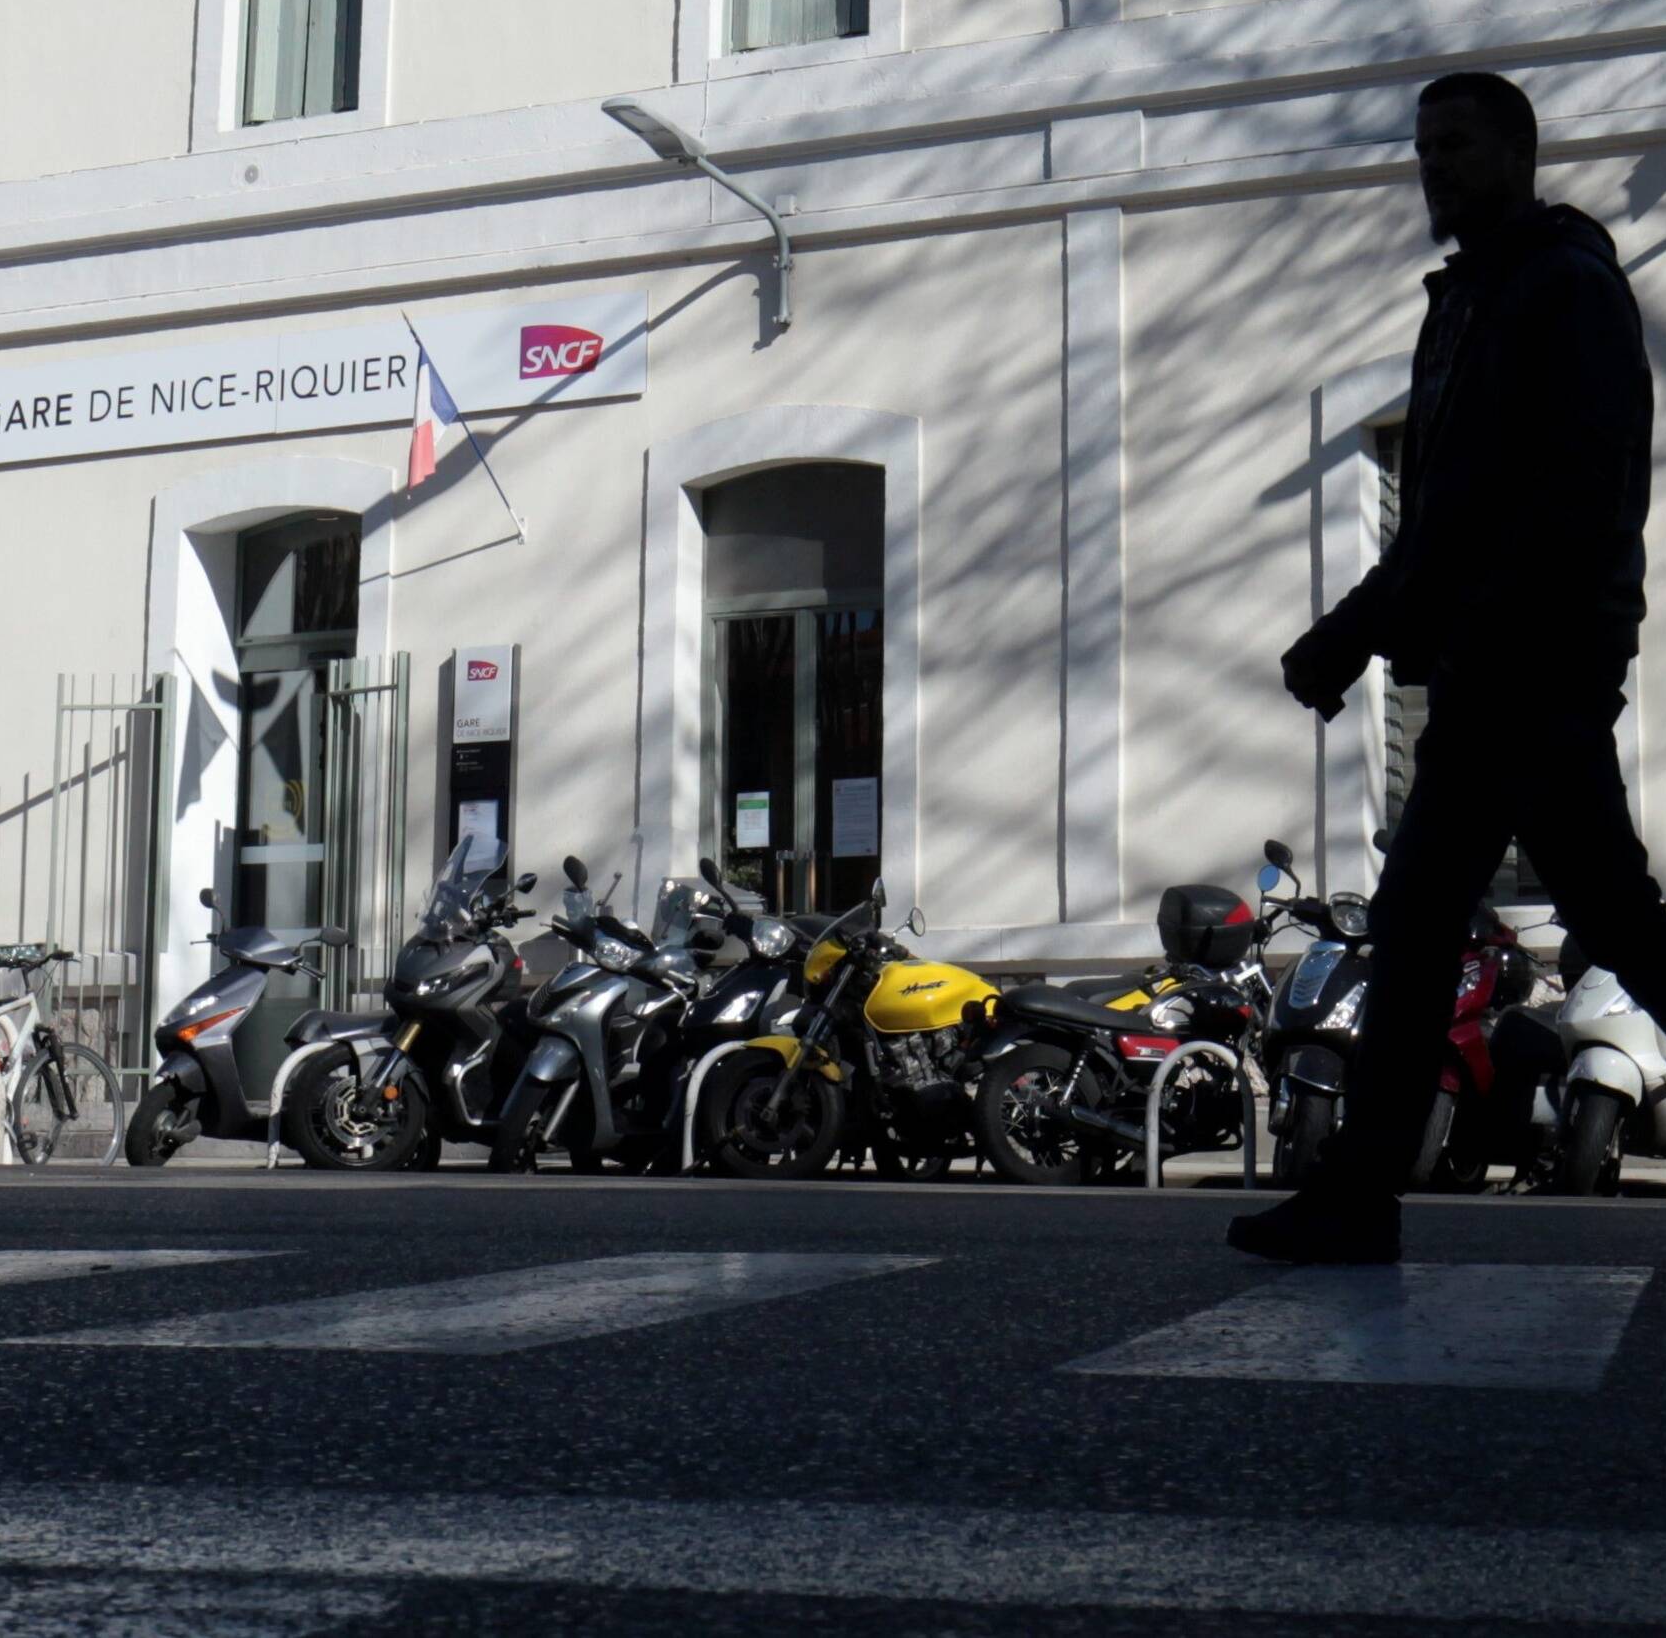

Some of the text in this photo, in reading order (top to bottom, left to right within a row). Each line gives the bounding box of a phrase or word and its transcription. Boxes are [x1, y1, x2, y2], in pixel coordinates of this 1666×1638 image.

[522, 339, 598, 373] SNCF
[89, 385, 135, 423] DE
[150, 354, 407, 416] NICE-RIQUIER
[469, 667, 496, 679] SNCF
[456, 718, 480, 728] GARE
